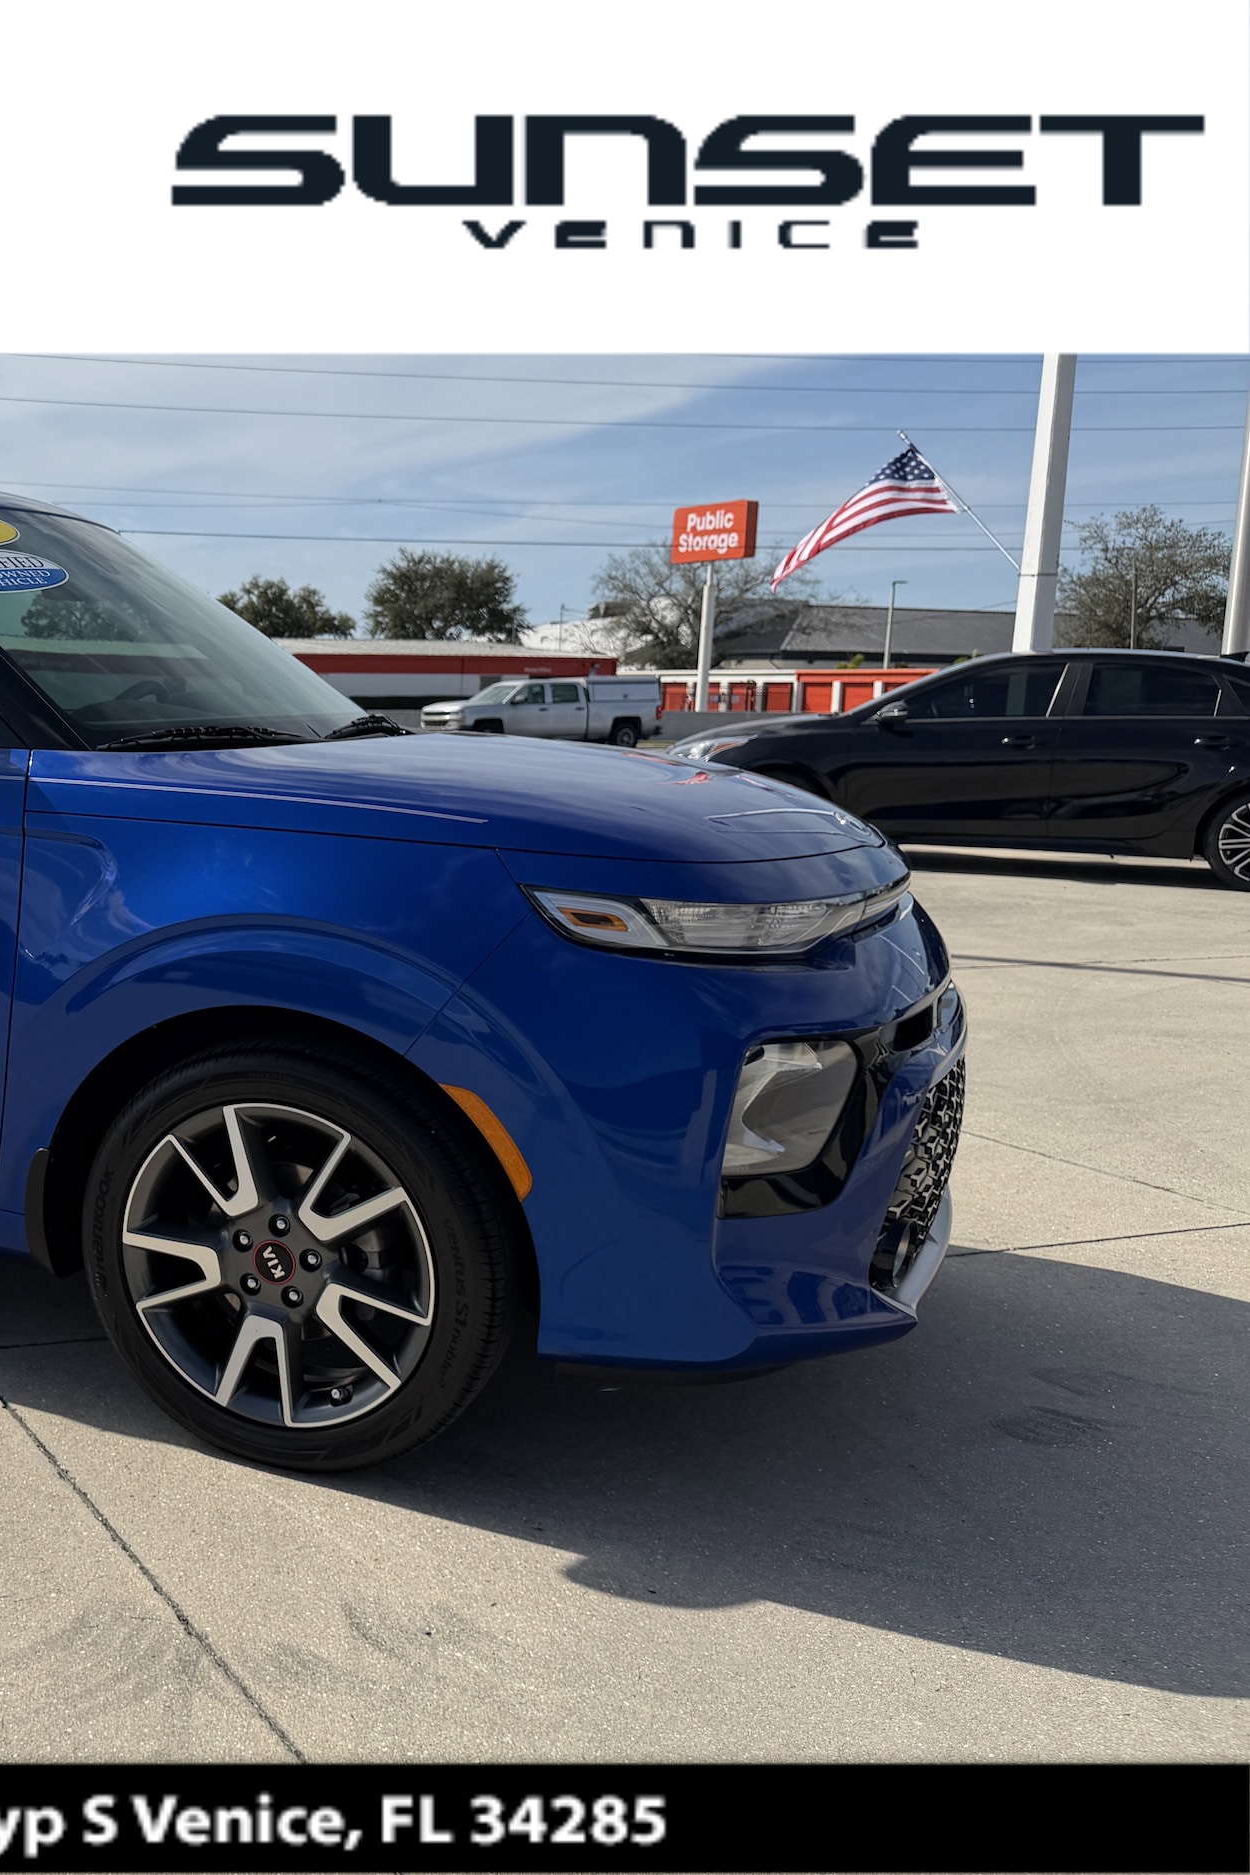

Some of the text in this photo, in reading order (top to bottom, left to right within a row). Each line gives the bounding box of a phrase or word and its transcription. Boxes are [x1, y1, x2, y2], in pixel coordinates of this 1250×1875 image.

[686, 509, 735, 532] Public
[678, 532, 739, 555] Storage
[262, 1245, 286, 1280] KIA
